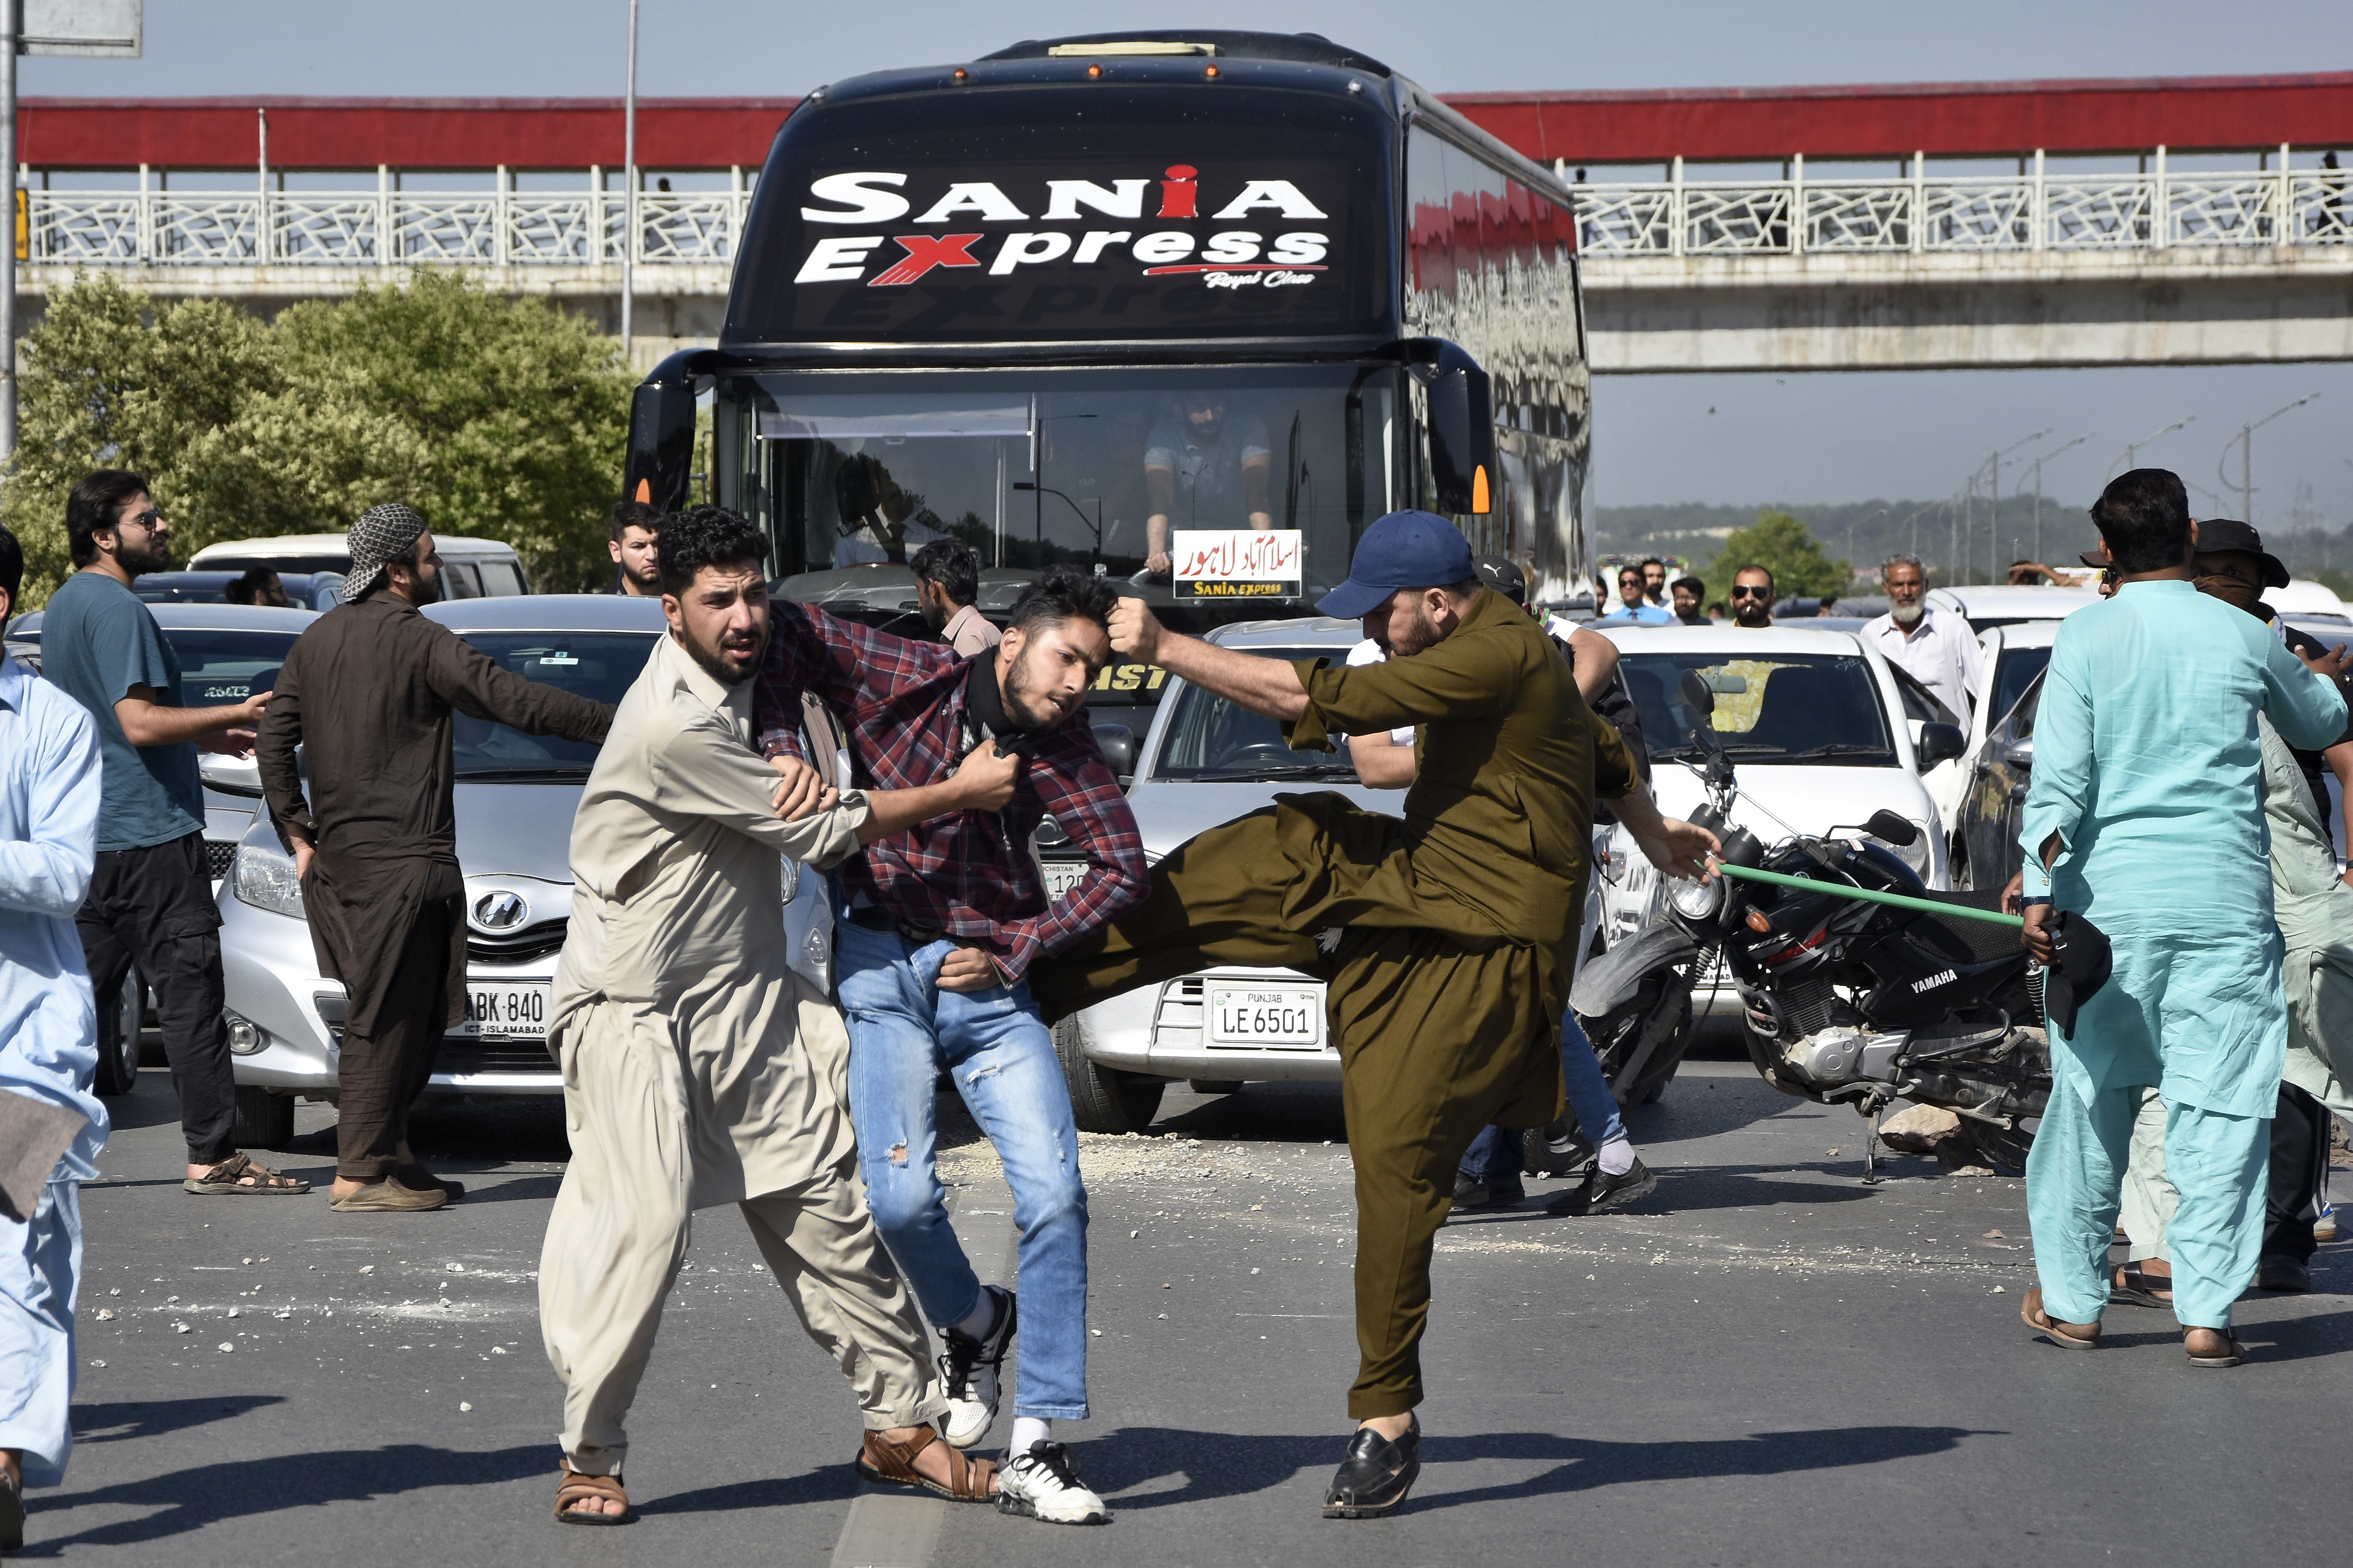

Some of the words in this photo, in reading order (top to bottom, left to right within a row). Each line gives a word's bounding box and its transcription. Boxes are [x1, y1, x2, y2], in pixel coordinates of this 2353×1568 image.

[1203, 271, 1262, 289] Royal
[1263, 270, 1315, 287] Class
[1911, 969, 1957, 993] YAMAHA
[1248, 994, 1282, 1003] PUNJAB
